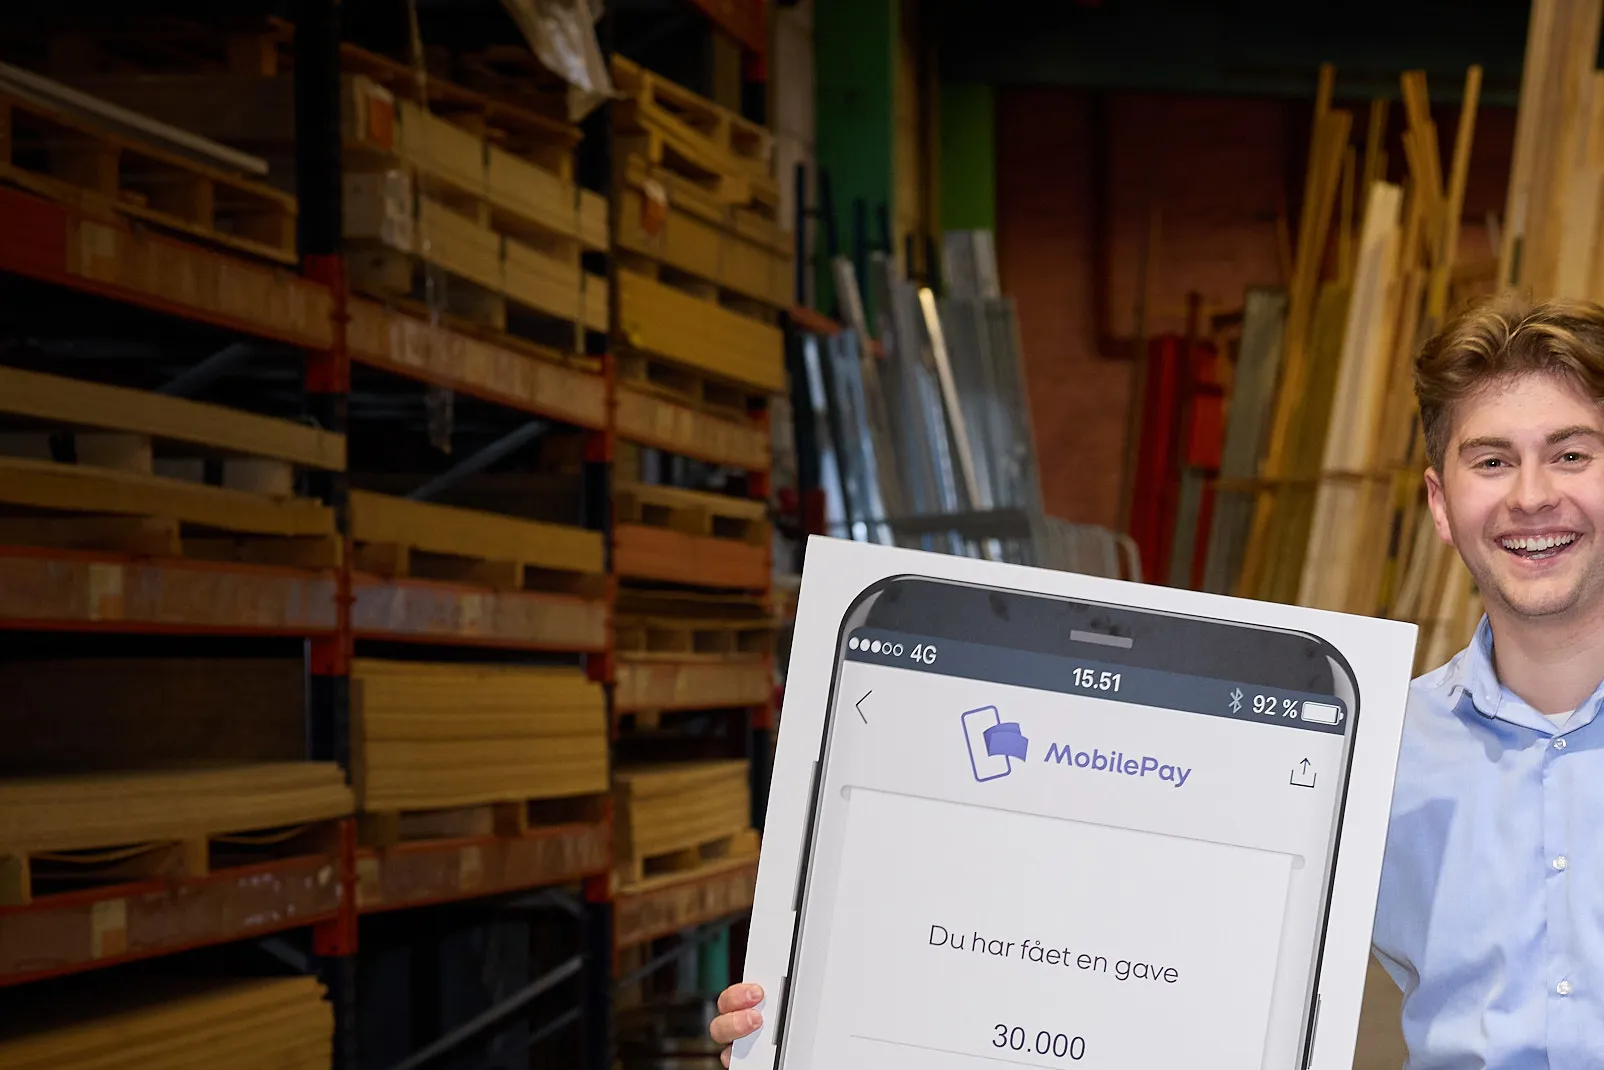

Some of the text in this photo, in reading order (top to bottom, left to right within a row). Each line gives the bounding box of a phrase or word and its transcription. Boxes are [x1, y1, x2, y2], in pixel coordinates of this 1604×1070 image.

[910, 644, 938, 665] 4G
[1072, 667, 1122, 693] 15.51
[1252, 695, 1279, 717] 92
[1044, 742, 1192, 788] MobilePay
[929, 924, 1179, 984] Du har fået en gave
[992, 1023, 1086, 1060] 30.000
